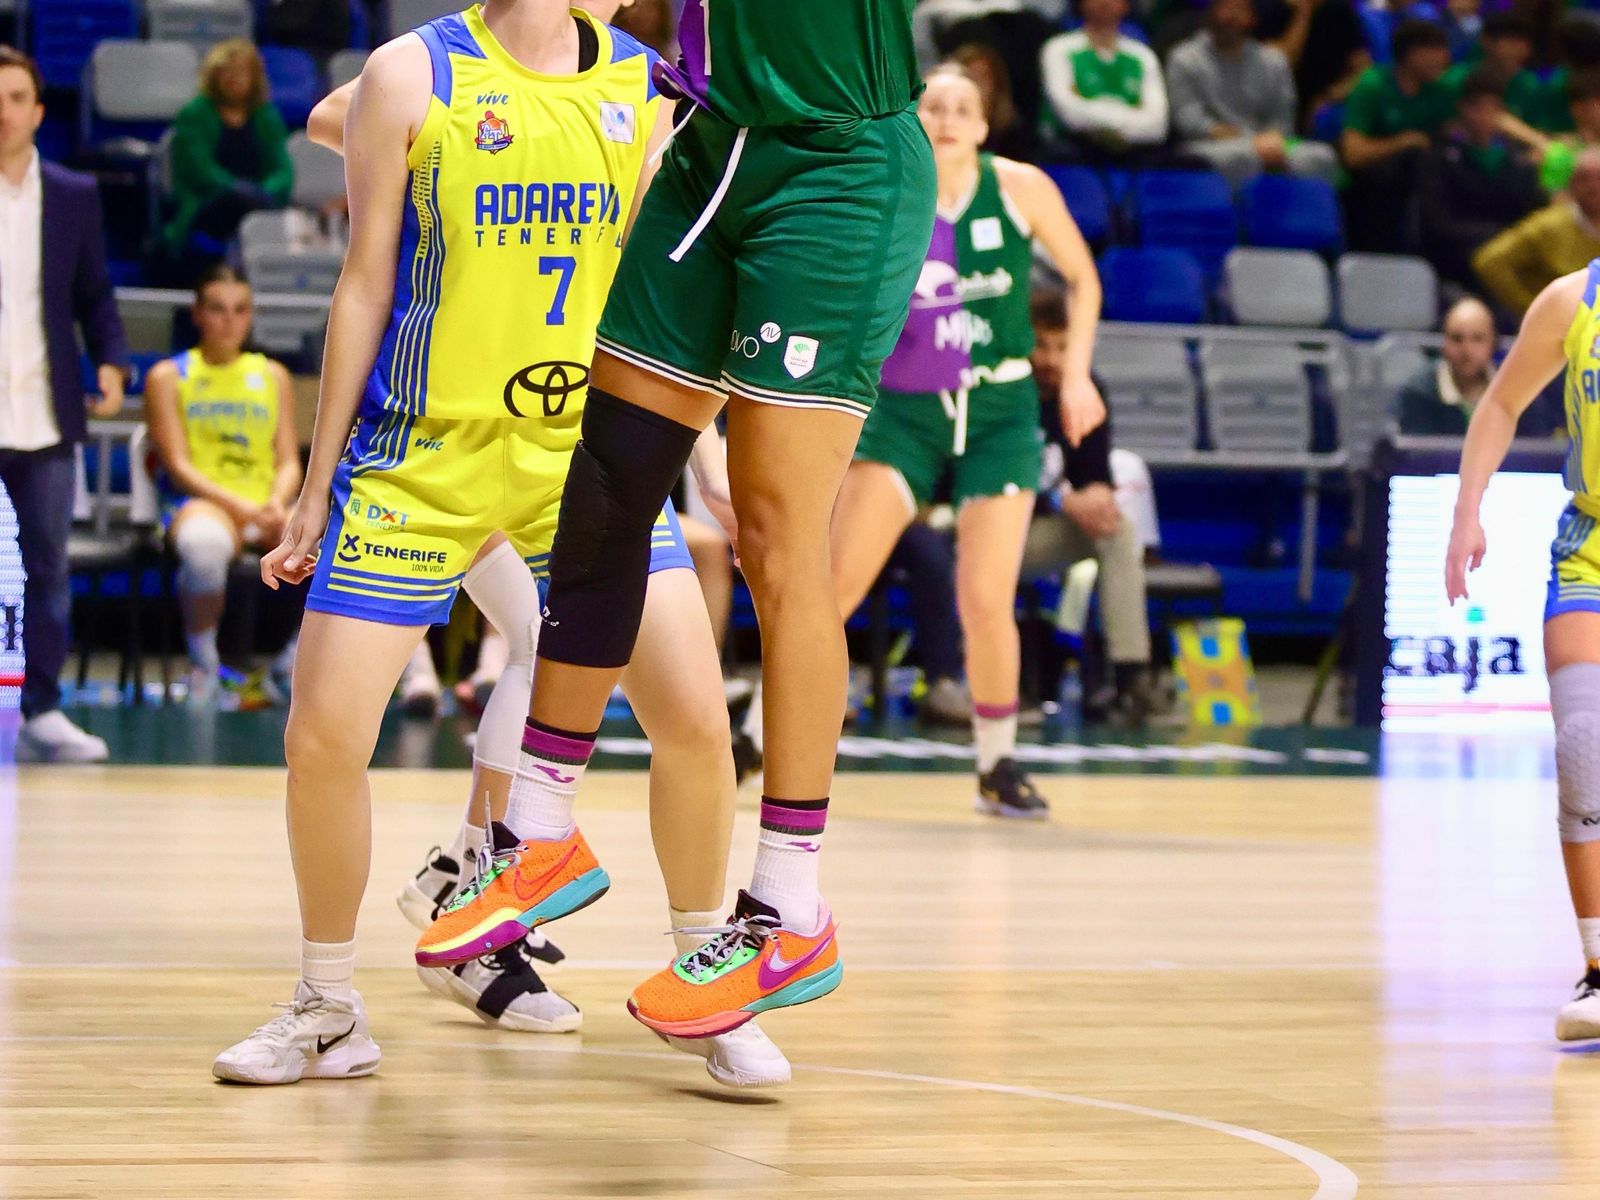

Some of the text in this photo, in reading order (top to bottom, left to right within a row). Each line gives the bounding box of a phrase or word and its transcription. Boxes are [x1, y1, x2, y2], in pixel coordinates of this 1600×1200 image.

[538, 256, 577, 325] 7
[367, 504, 409, 526] DXT
[364, 542, 447, 563] TENERIFE
[411, 563, 444, 573] 100% VIDA
